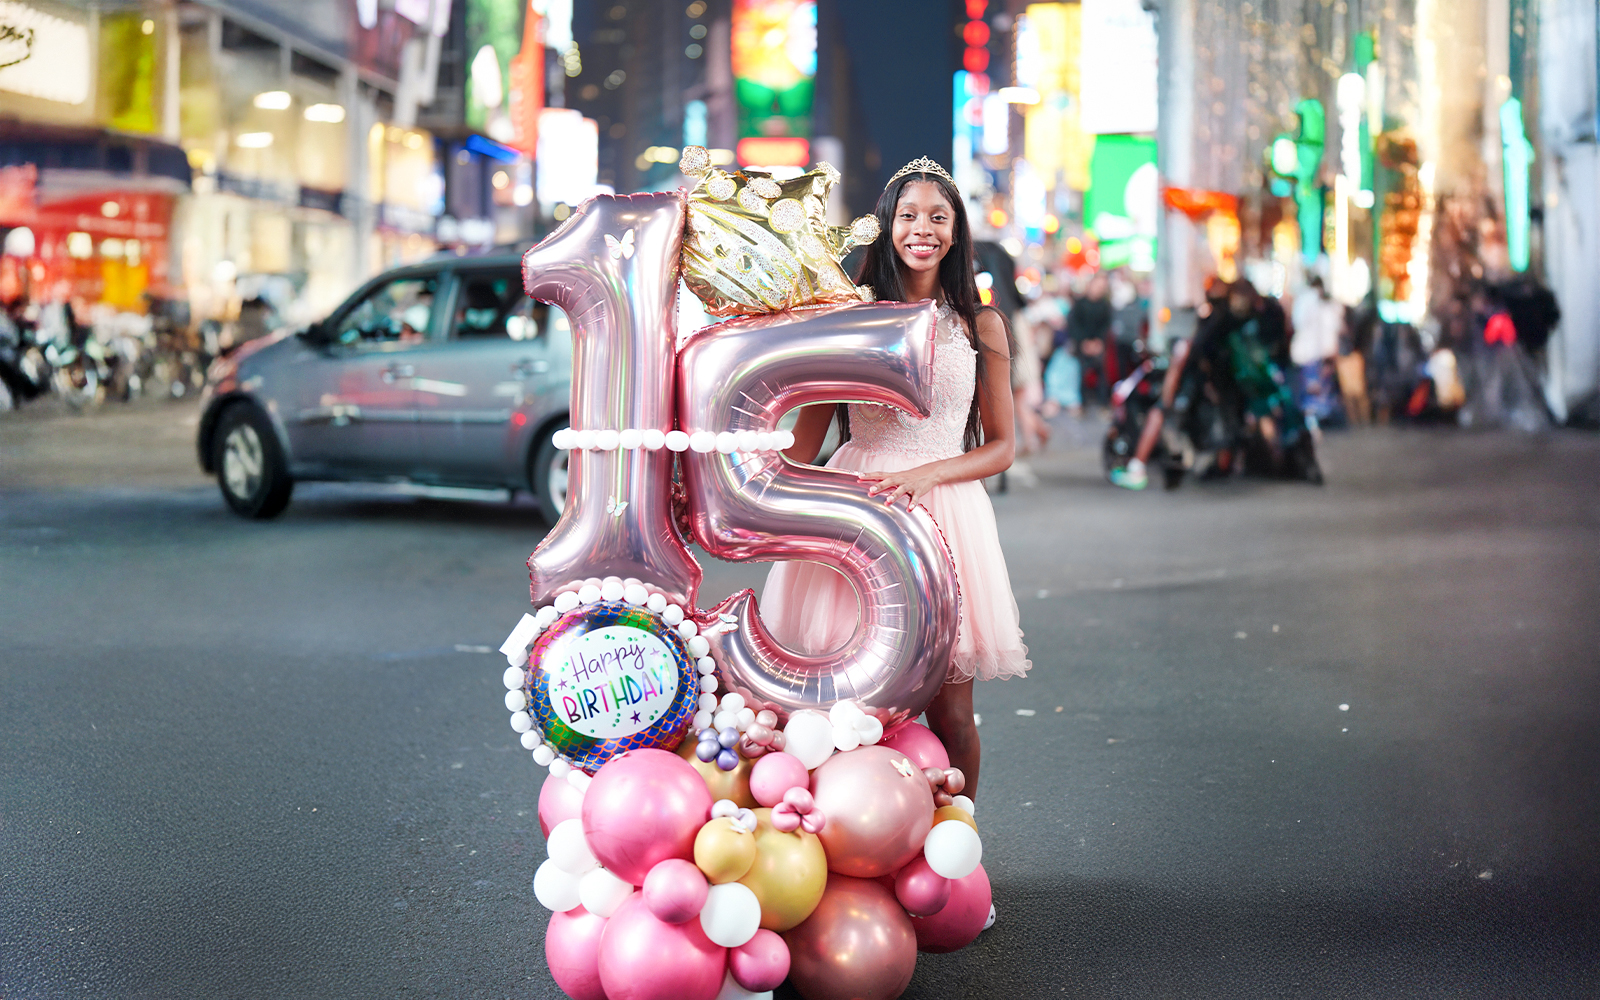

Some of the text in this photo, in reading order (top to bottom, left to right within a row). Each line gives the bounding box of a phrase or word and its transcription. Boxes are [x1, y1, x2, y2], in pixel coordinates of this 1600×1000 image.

[522, 187, 961, 717] 15
[562, 662, 673, 724] BIRTHDAY!
[570, 644, 646, 683] Happy
